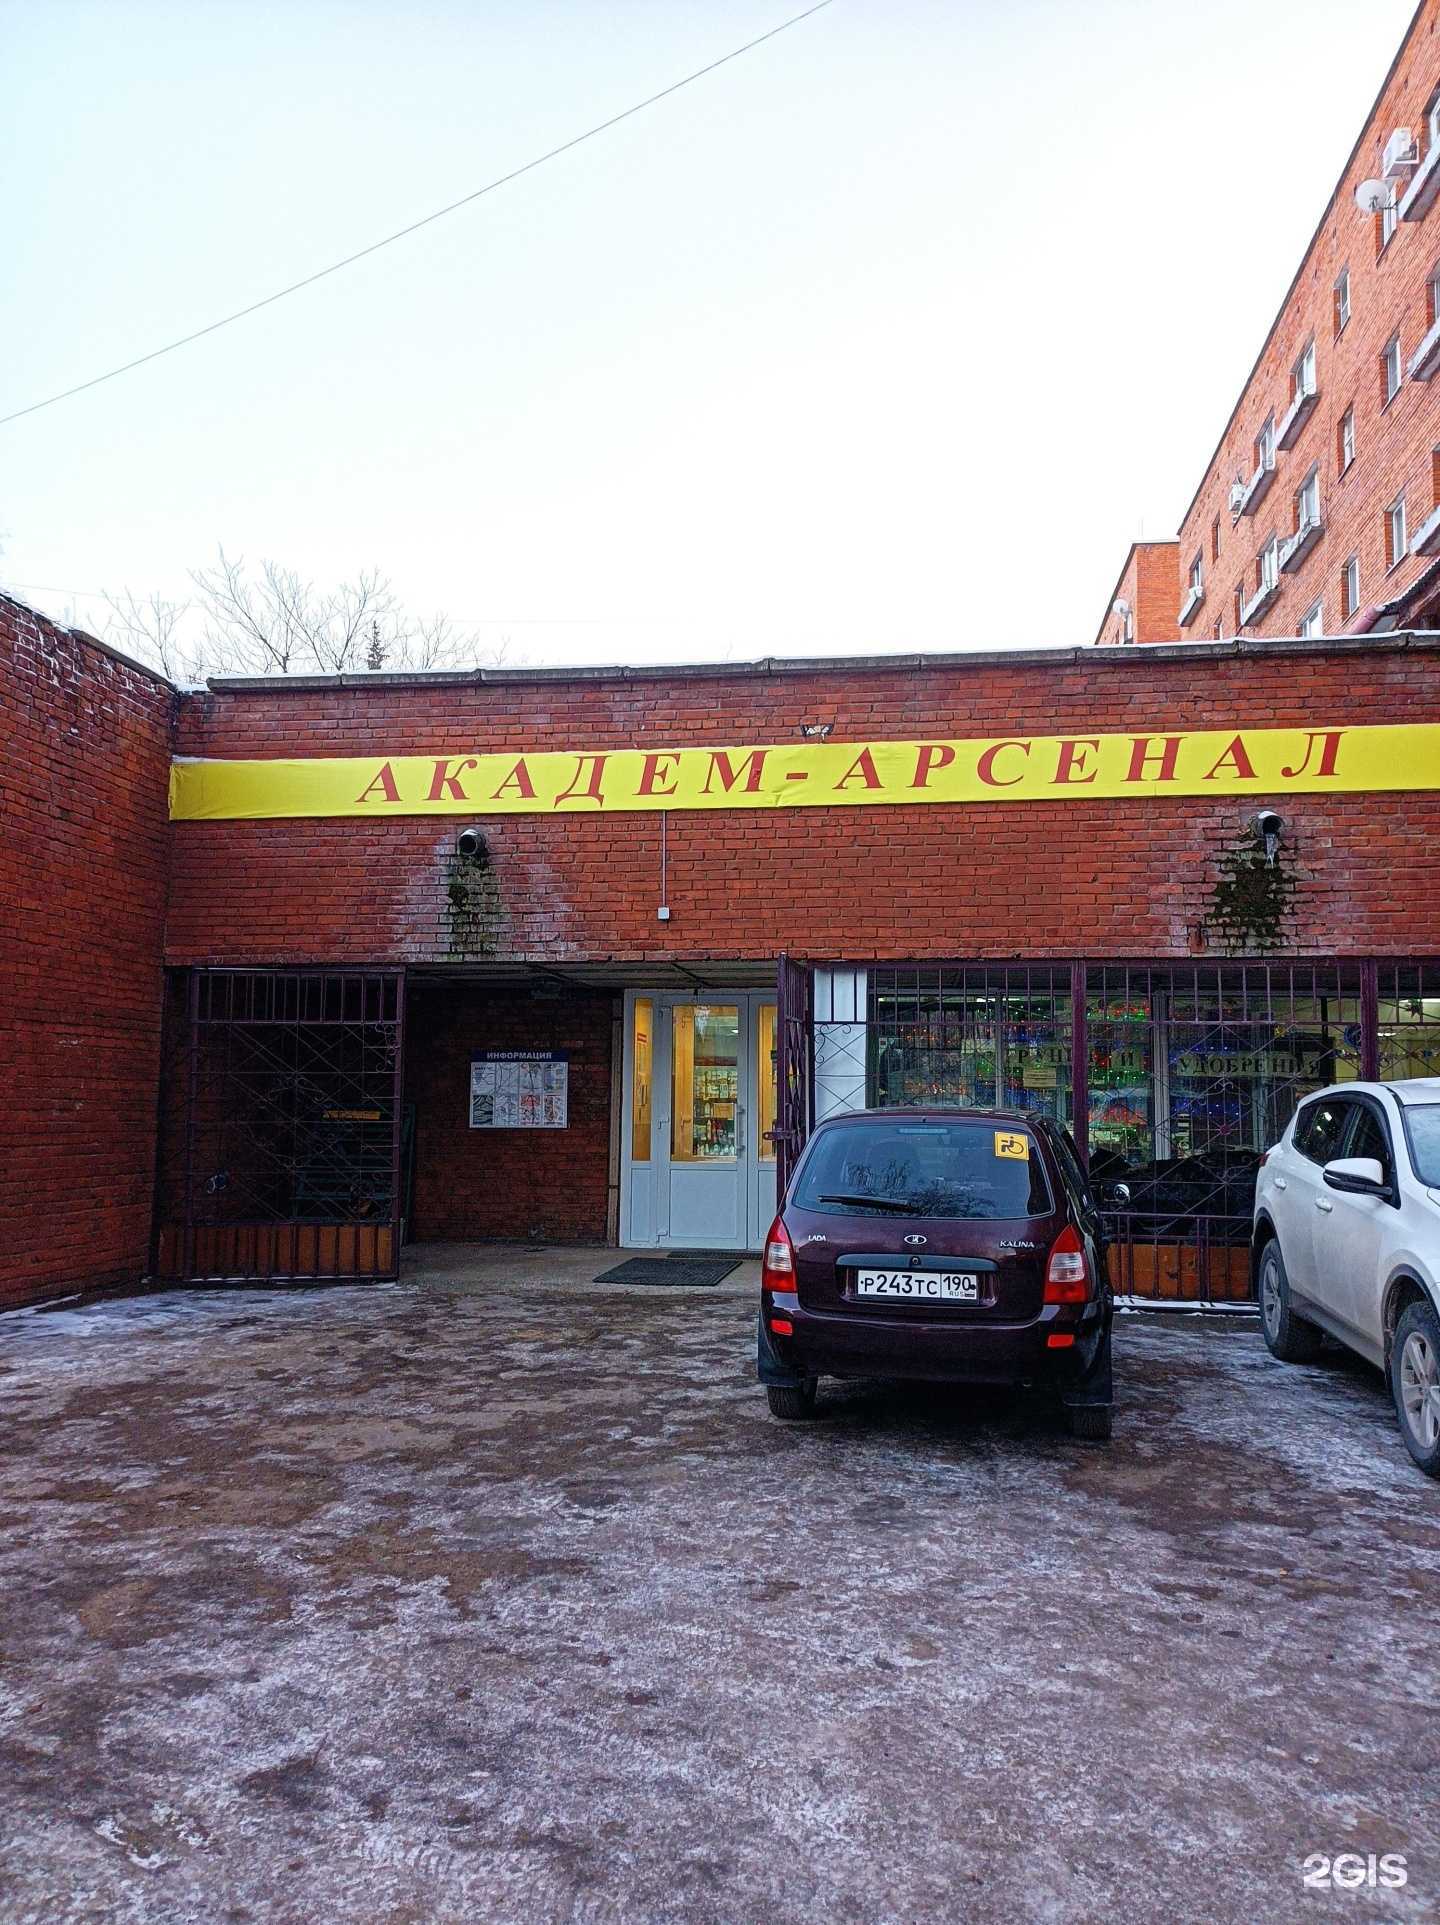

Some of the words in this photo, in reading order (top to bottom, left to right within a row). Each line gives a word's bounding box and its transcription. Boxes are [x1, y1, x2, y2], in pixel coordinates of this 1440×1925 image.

[486, 1051, 553, 1060] ИНФОРМАЦИЯ
[808, 1234, 827, 1242] LADA
[1000, 1240, 1035, 1249] KALINA
[943, 1275, 972, 1292] 190
